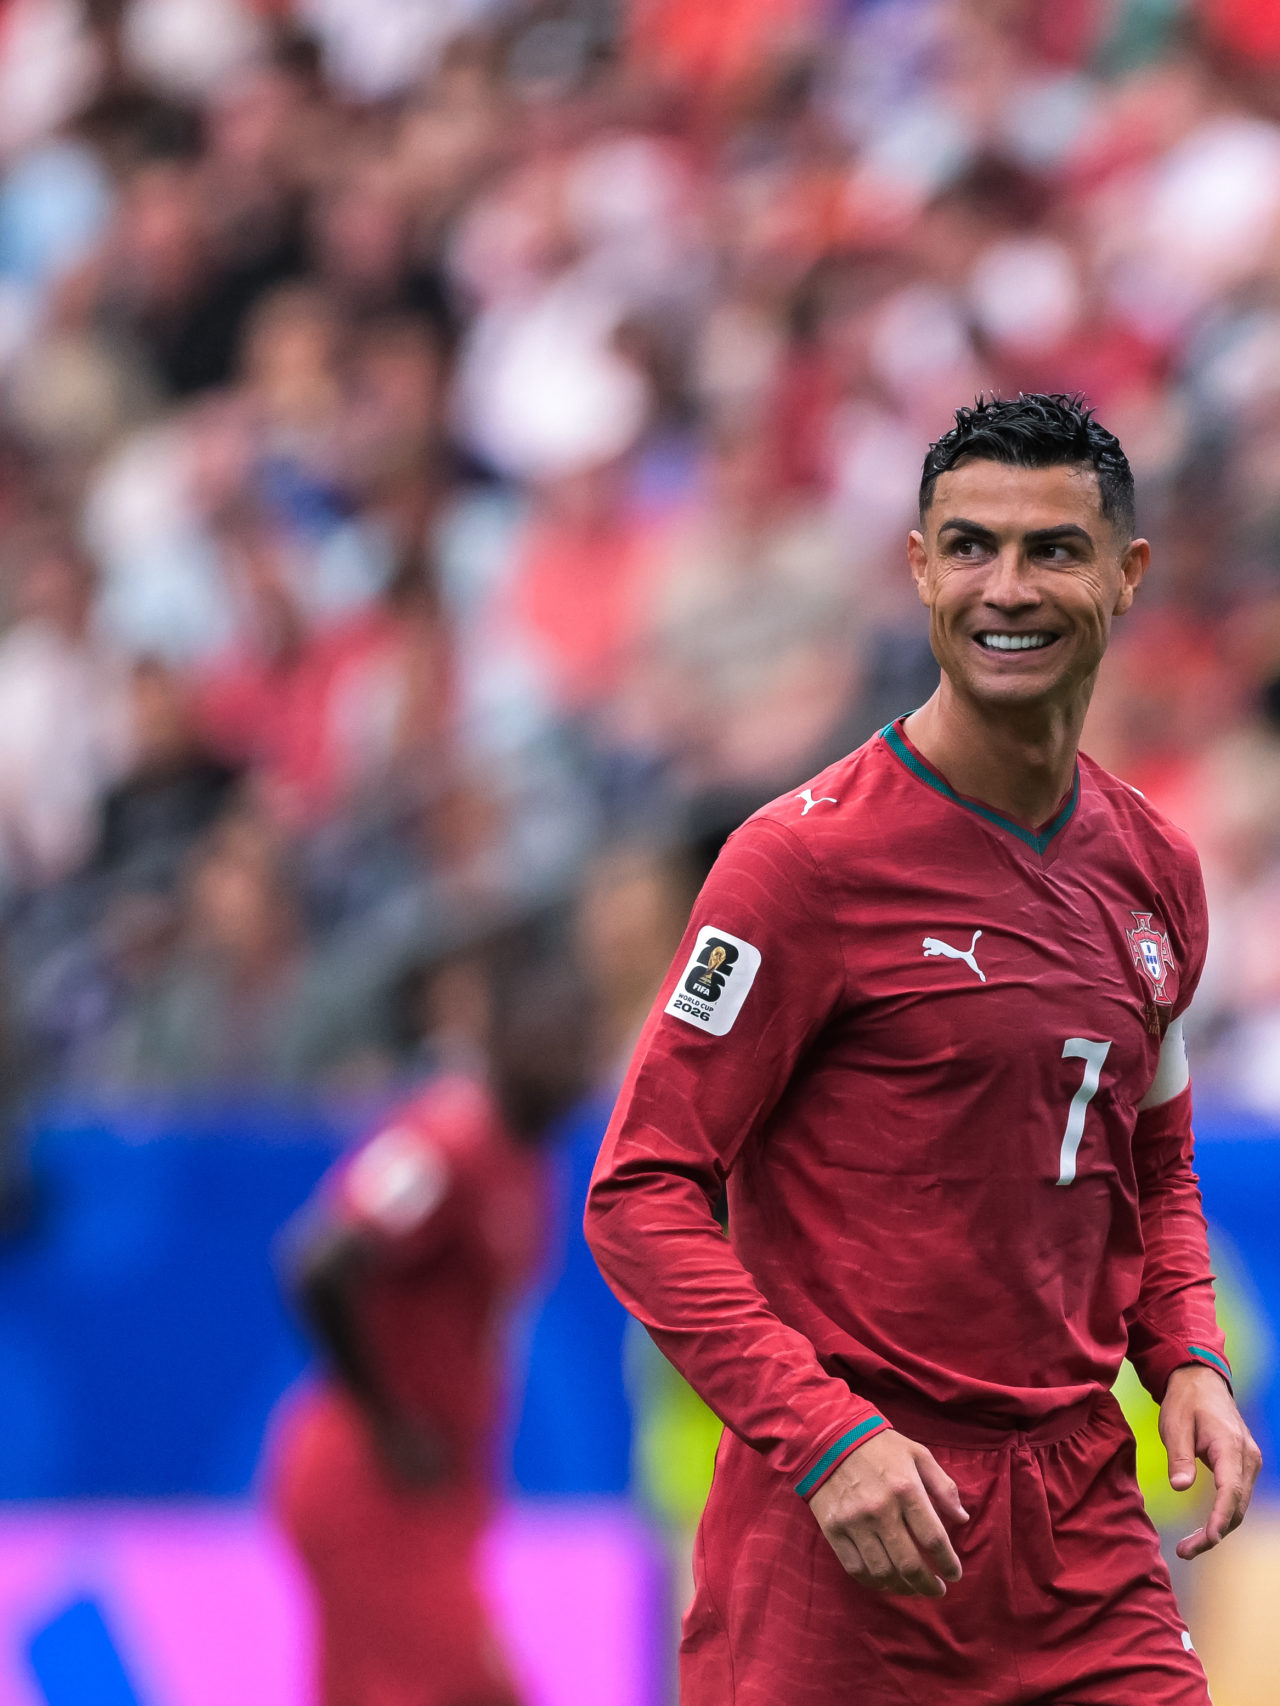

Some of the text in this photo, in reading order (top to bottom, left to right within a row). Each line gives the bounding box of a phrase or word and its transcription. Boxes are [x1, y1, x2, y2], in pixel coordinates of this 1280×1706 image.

[692, 983, 710, 996] FIFA
[673, 999, 711, 1021] 2026
[678, 993, 714, 1012] WORLD CUP
[1055, 1037, 1113, 1185] 7
